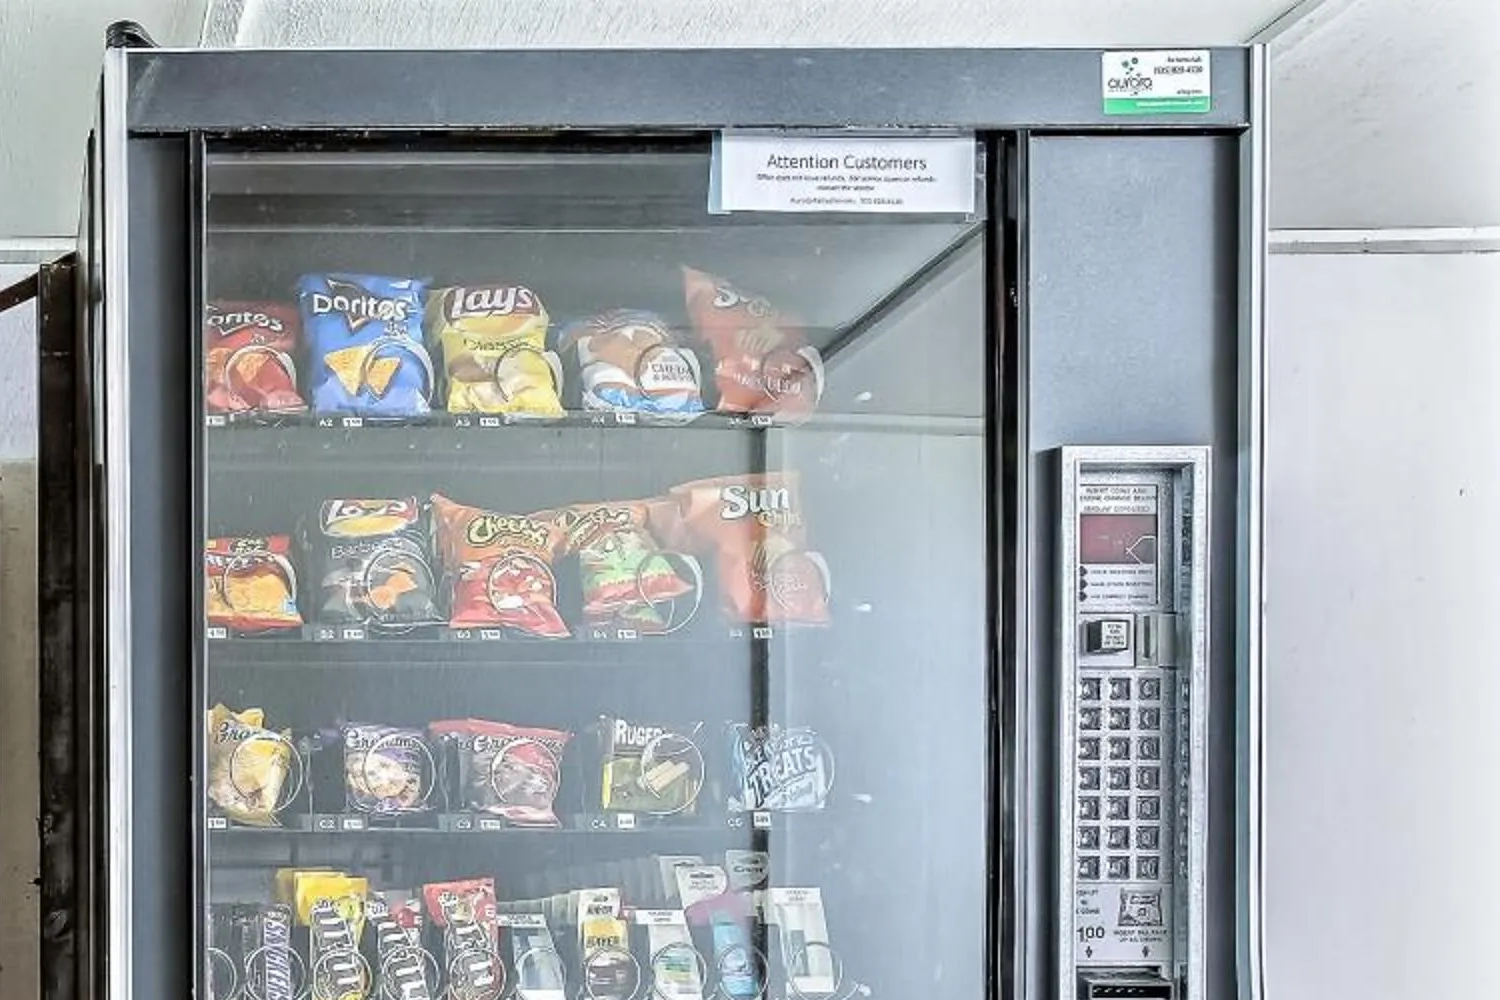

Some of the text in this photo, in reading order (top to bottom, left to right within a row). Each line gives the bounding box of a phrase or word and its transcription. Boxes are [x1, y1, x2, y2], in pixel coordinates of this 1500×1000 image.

[767, 153, 927, 170] Attention Customers
[312, 293, 408, 321] Doritos
[206, 311, 284, 332] oritos
[319, 419, 333, 427] A2
[720, 484, 790, 520] Sun
[591, 819, 607, 829] C4
